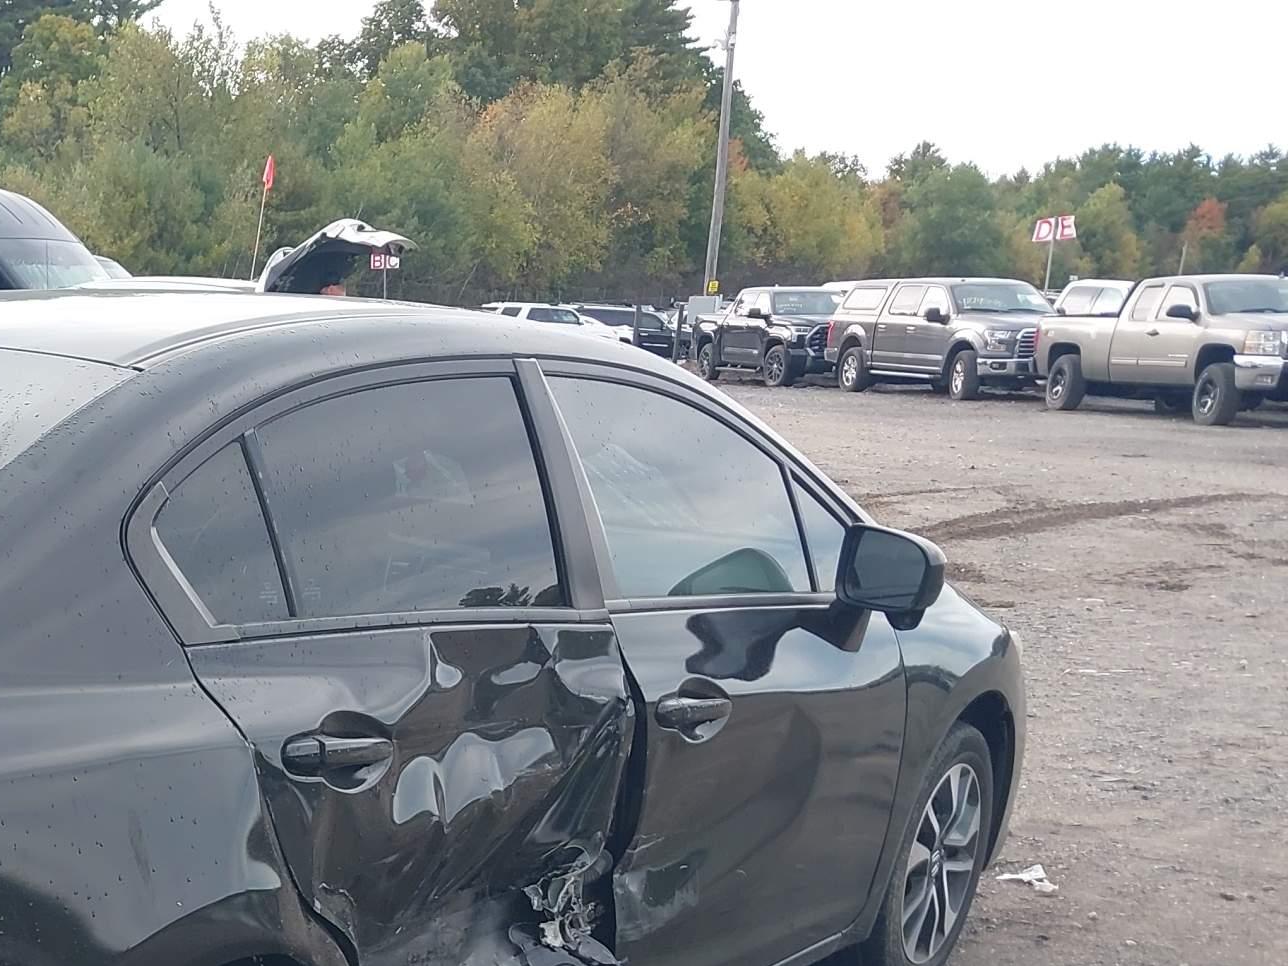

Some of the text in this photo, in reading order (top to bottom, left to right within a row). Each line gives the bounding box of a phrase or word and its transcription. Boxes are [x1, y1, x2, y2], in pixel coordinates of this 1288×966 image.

[1035, 216, 1074, 240] D E
[372, 254, 399, 268] B C
